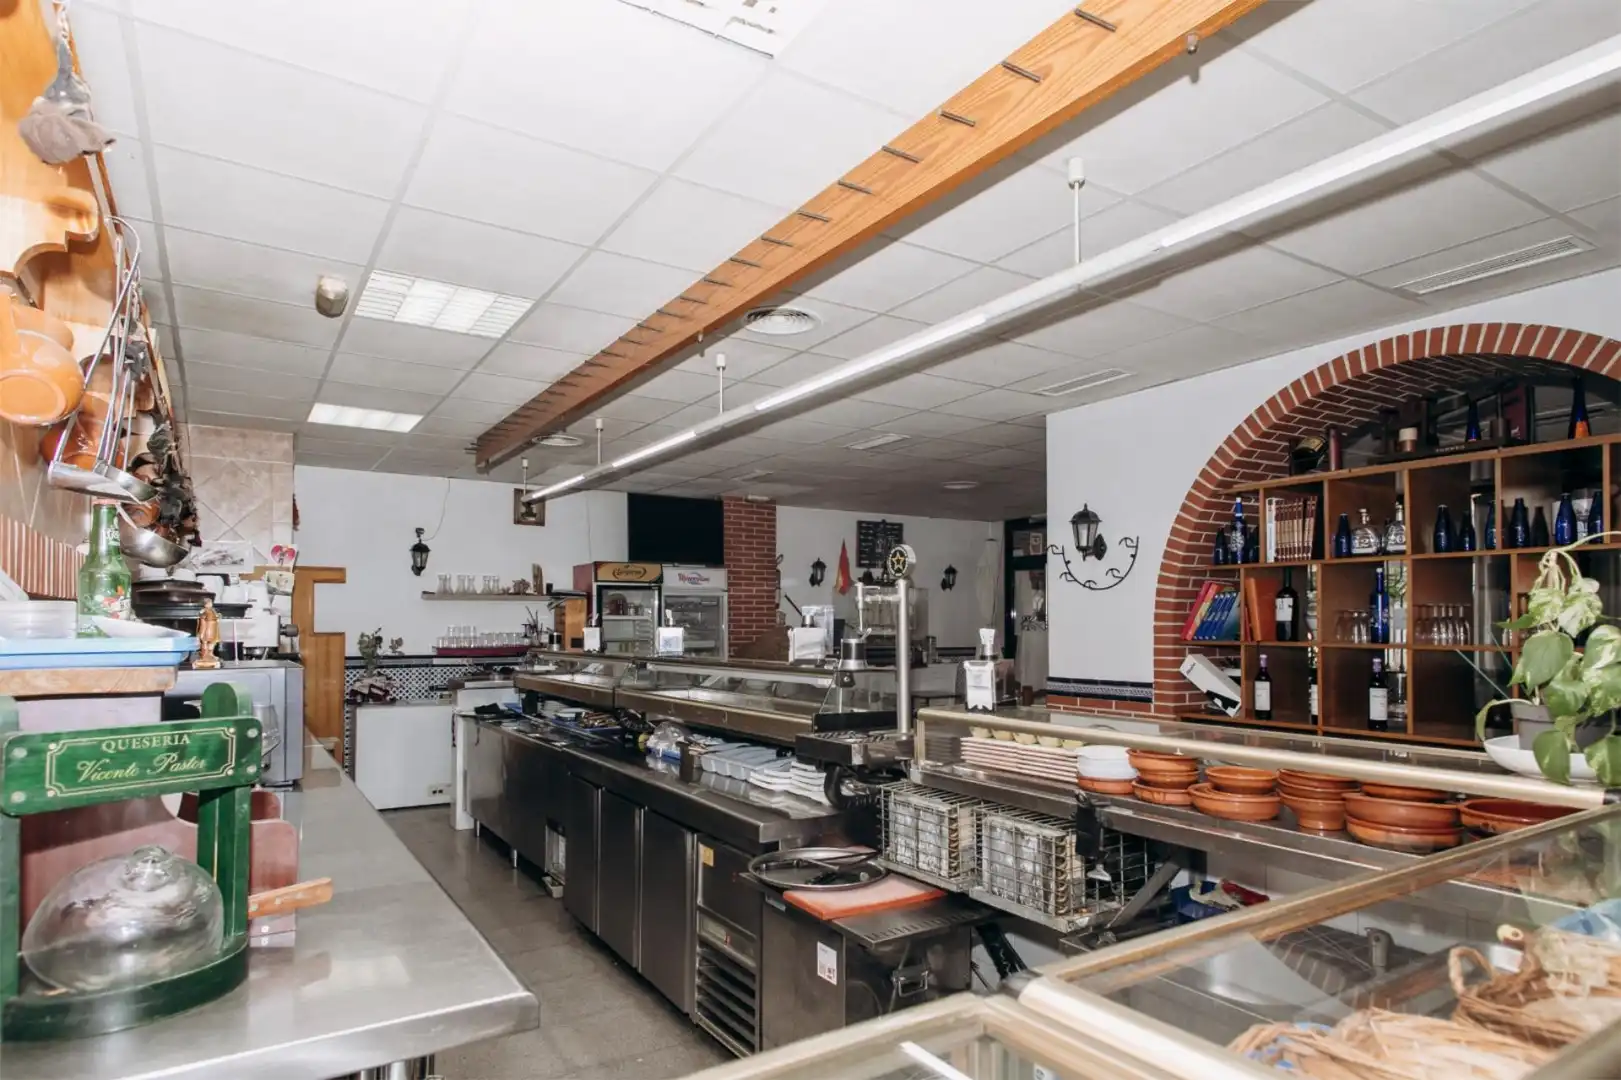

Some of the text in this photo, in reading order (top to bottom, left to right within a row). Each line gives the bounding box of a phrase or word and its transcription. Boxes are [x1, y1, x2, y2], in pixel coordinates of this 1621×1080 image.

[102, 734, 191, 753] QUESERIA
[77, 751, 208, 783] Vicente Pastor
